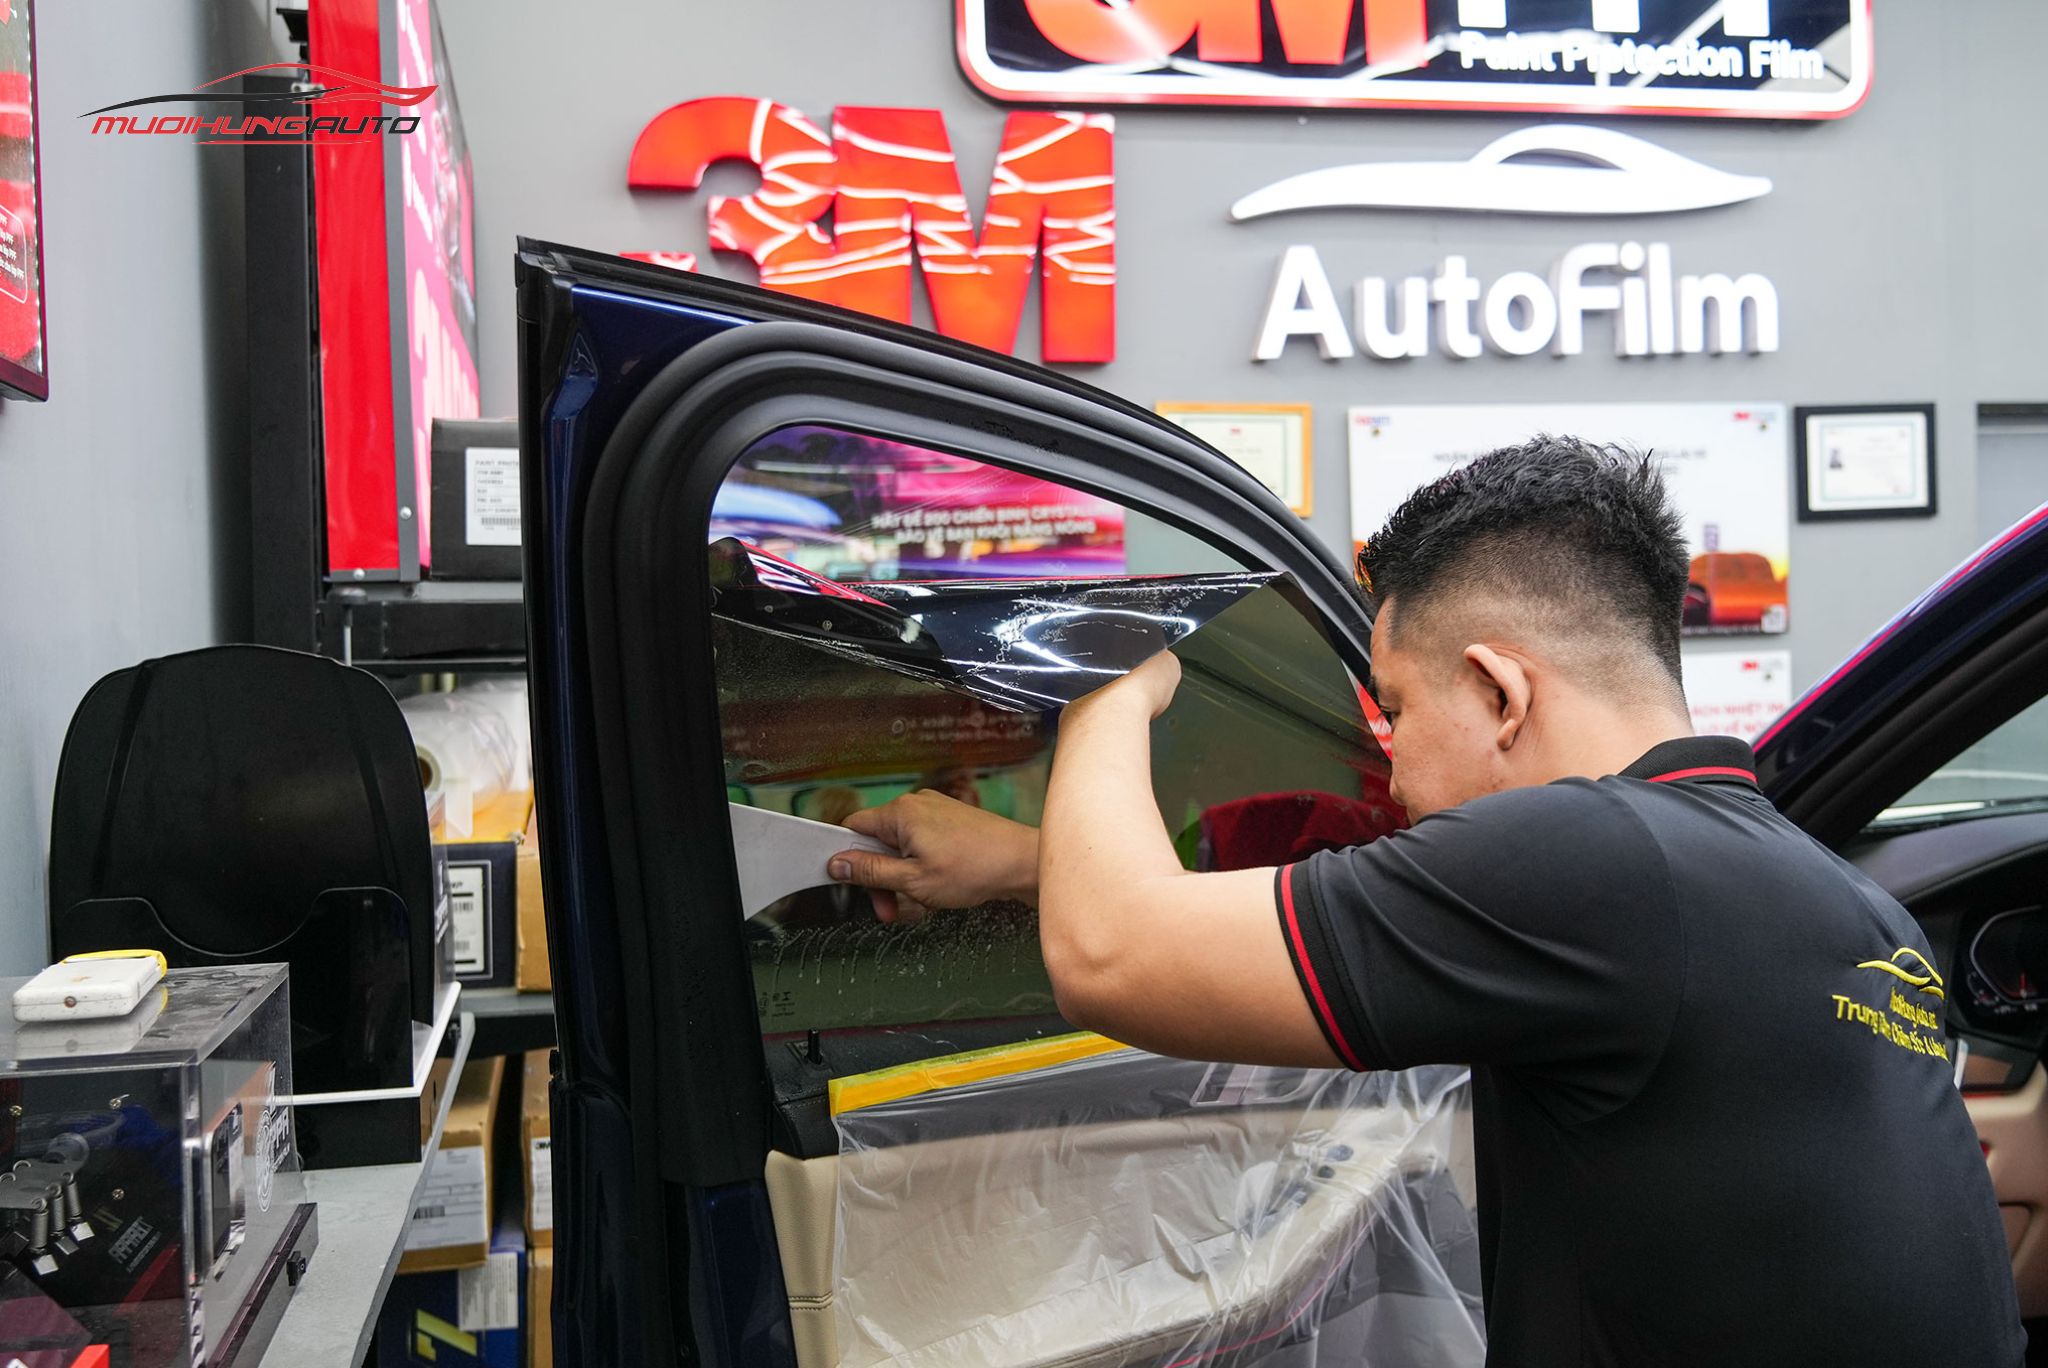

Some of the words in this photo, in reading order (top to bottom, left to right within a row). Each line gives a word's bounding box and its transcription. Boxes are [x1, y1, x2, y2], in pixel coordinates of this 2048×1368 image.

[1459, 30, 1556, 72] Paint
[1562, 32, 1744, 77] Protection
[1749, 39, 1824, 80] Film
[622, 96, 1116, 362] 3M
[1252, 242, 1779, 361] AutoFilm
[1831, 994, 1879, 1035] Trung
